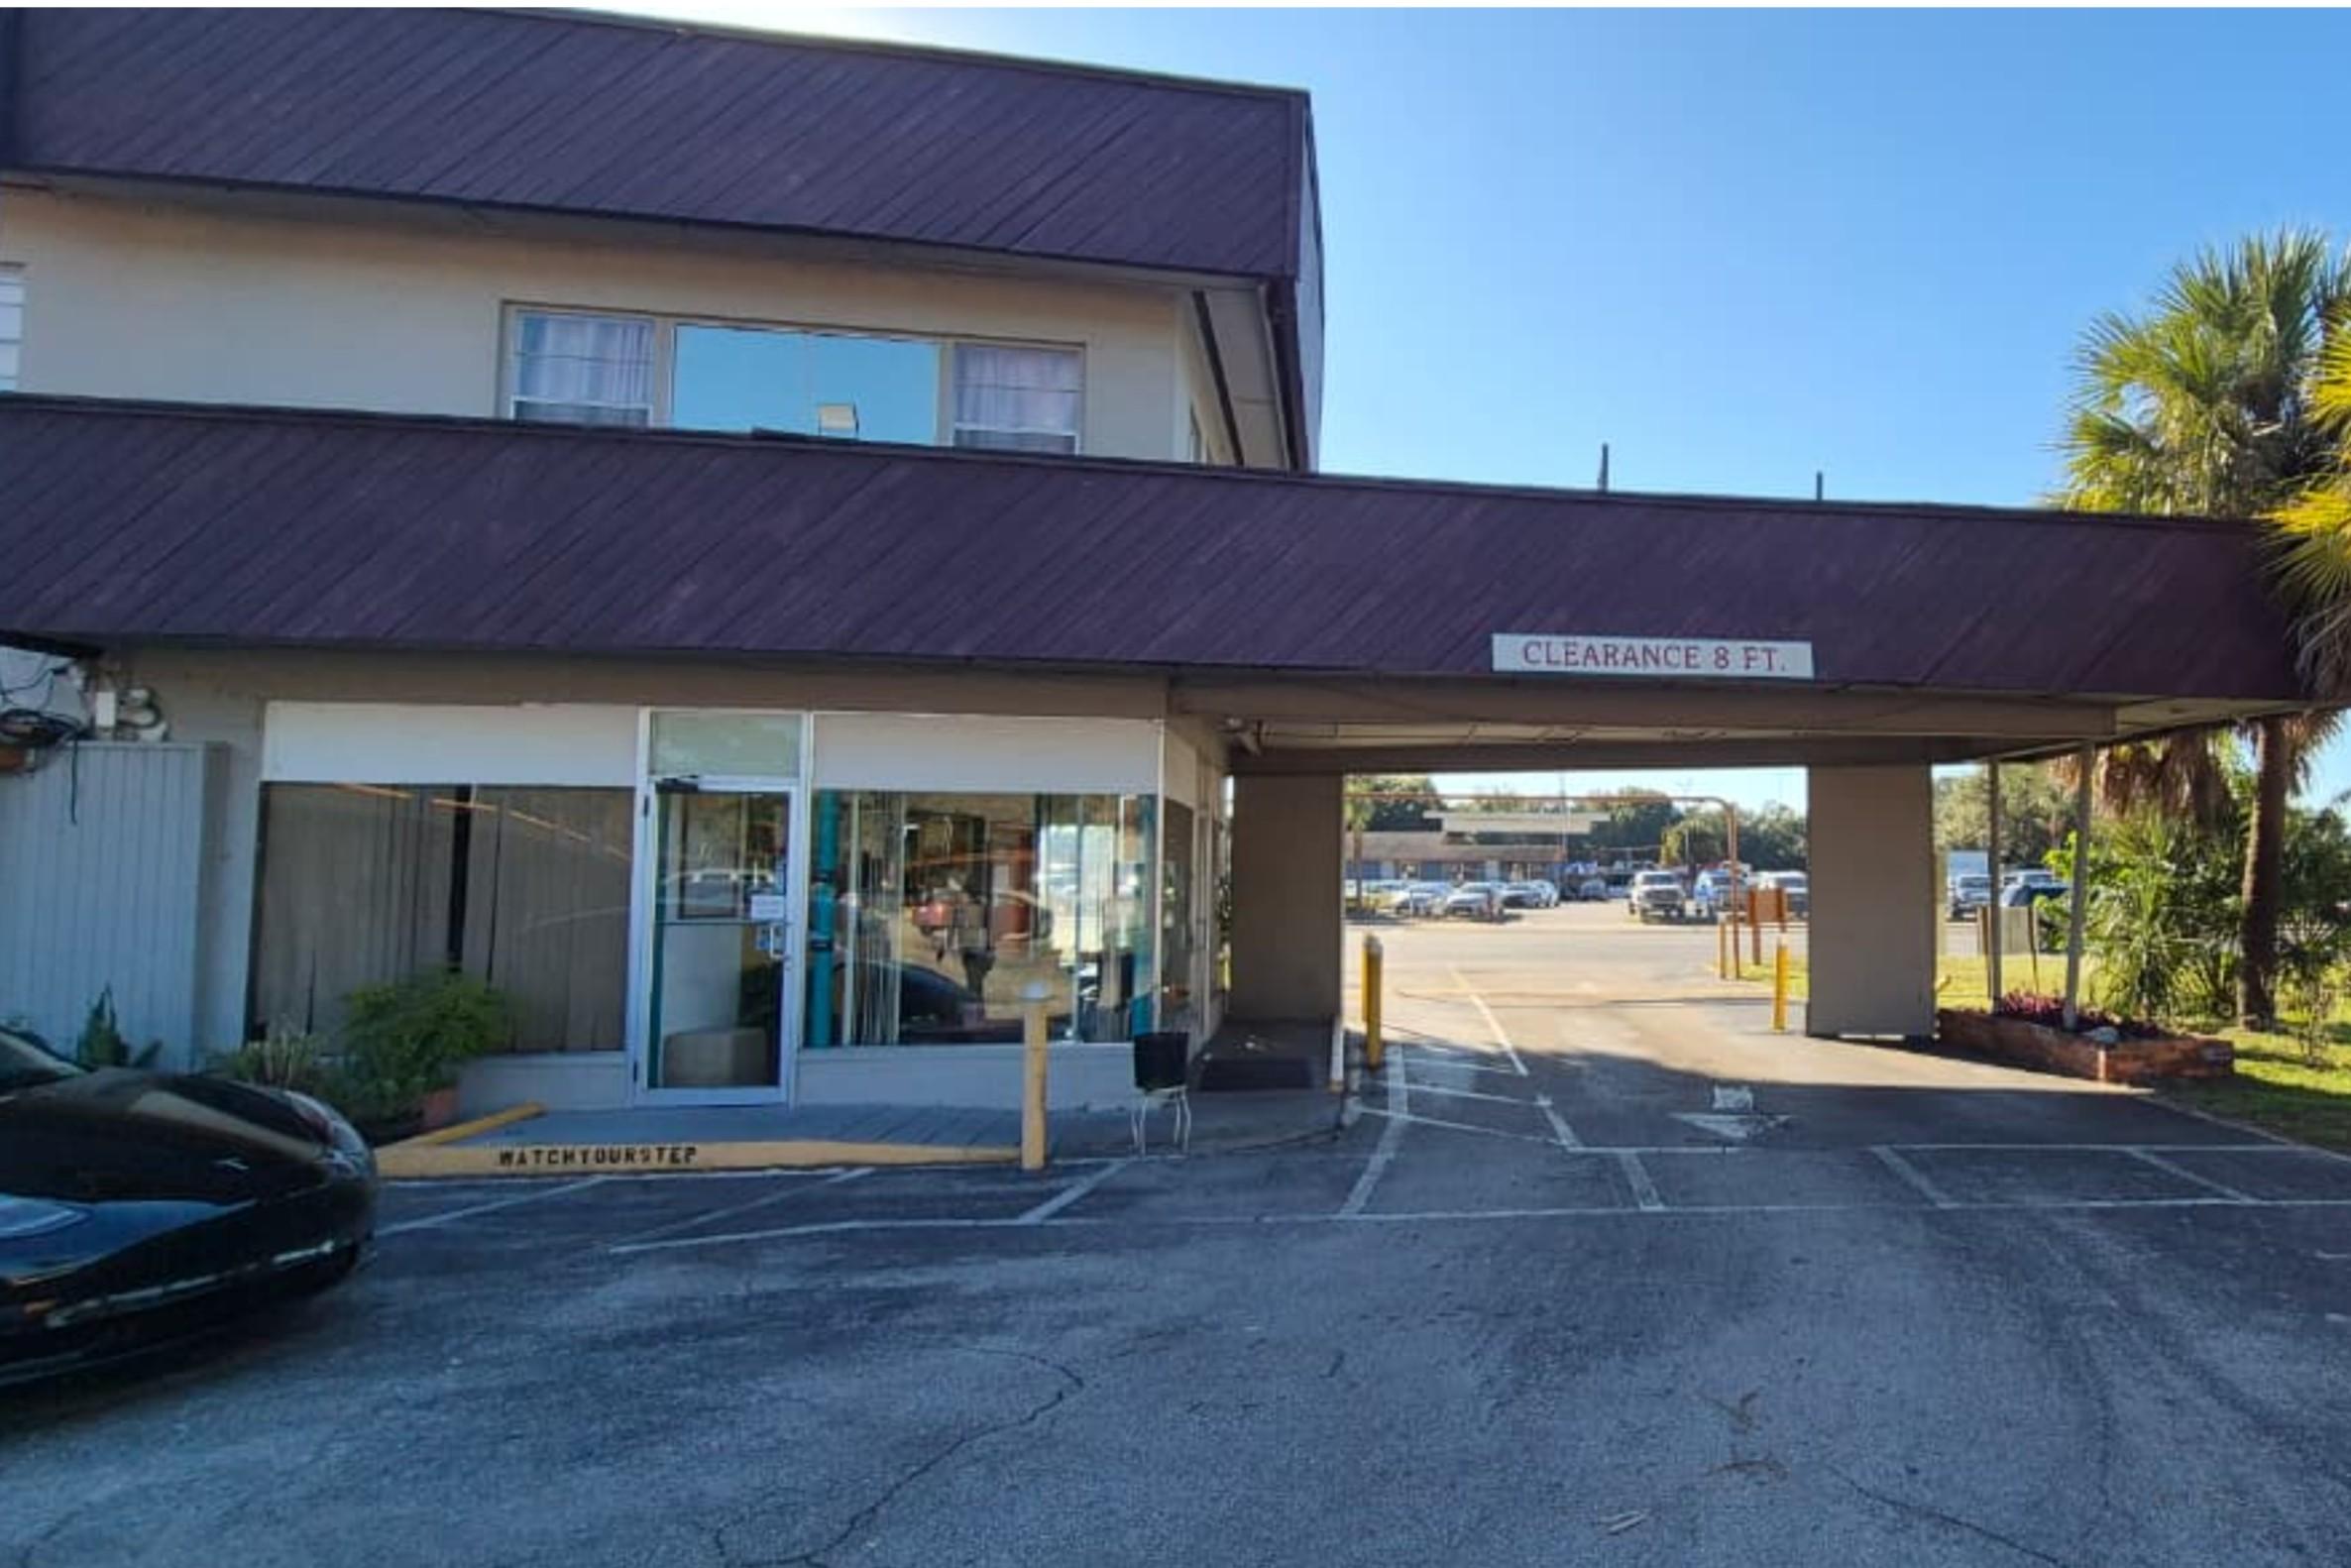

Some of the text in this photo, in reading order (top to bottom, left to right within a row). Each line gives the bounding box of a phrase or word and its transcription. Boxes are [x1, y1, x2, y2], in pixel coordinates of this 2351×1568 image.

[1522, 640, 1787, 672] CLEARANCE 8 FT.
